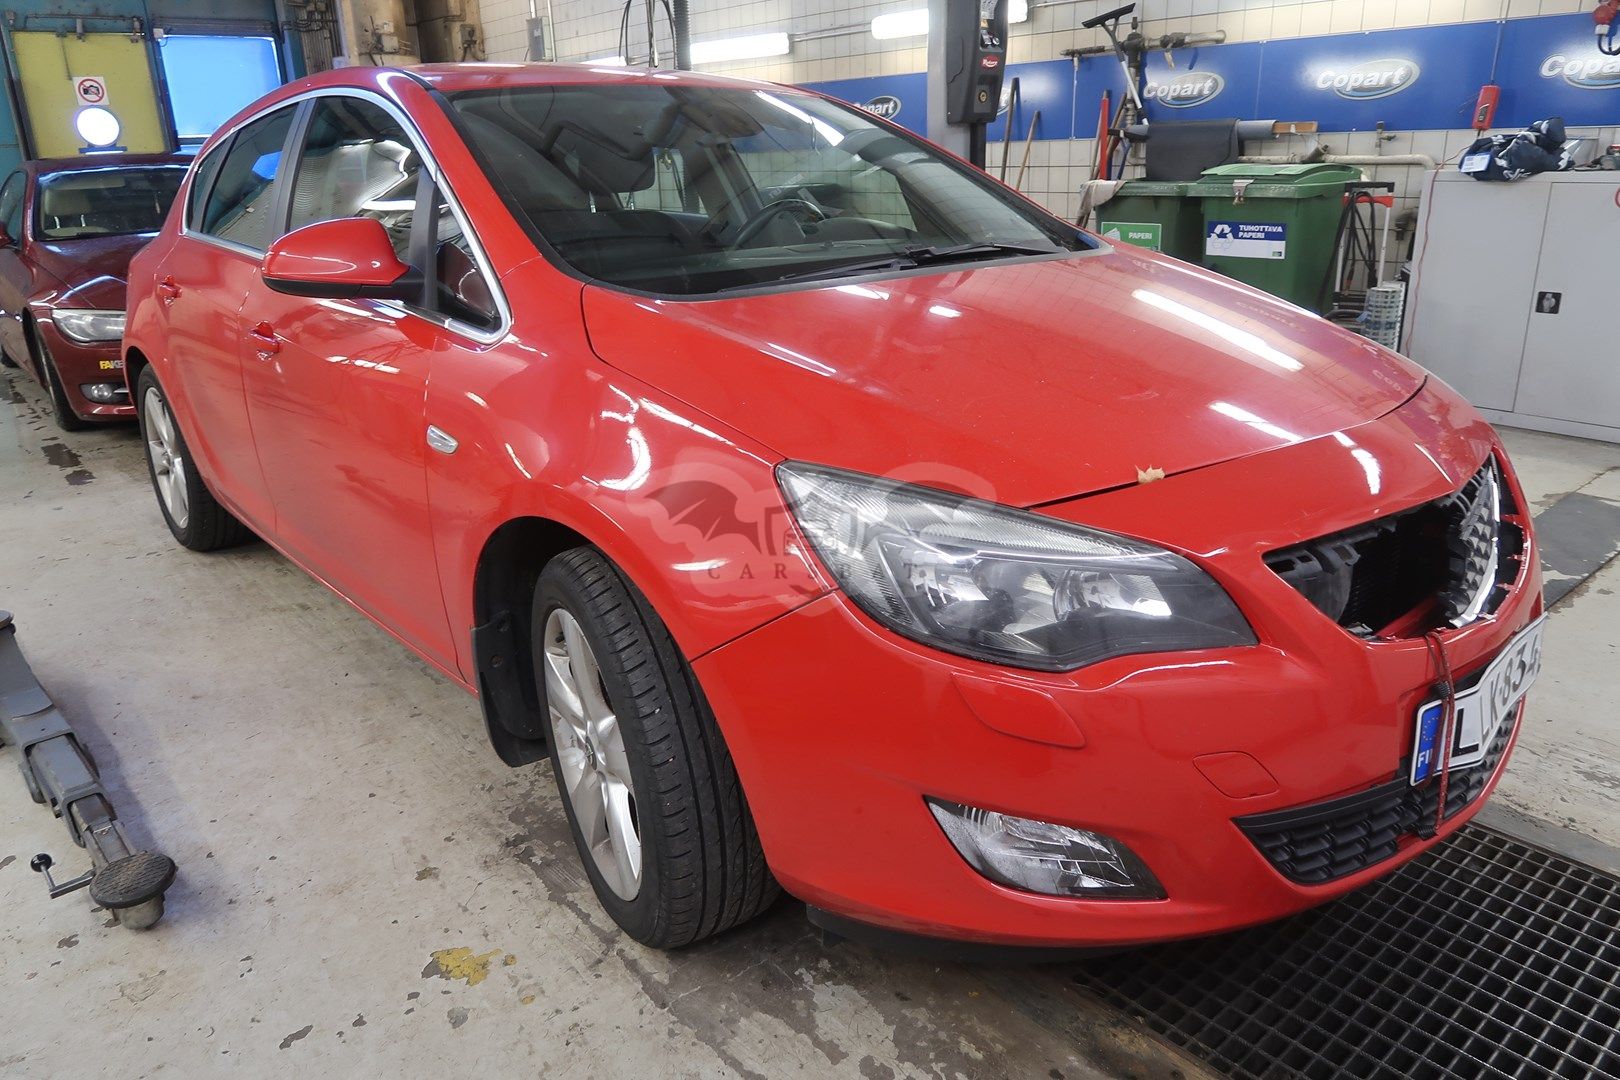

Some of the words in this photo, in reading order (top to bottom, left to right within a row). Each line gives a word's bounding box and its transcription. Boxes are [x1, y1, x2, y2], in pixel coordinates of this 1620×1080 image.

[1317, 63, 1406, 93] Copart
[1144, 80, 1211, 101] Copart
[1128, 231, 1152, 239] PAPERI
[1239, 224, 1283, 232] TUHOTTAVA
